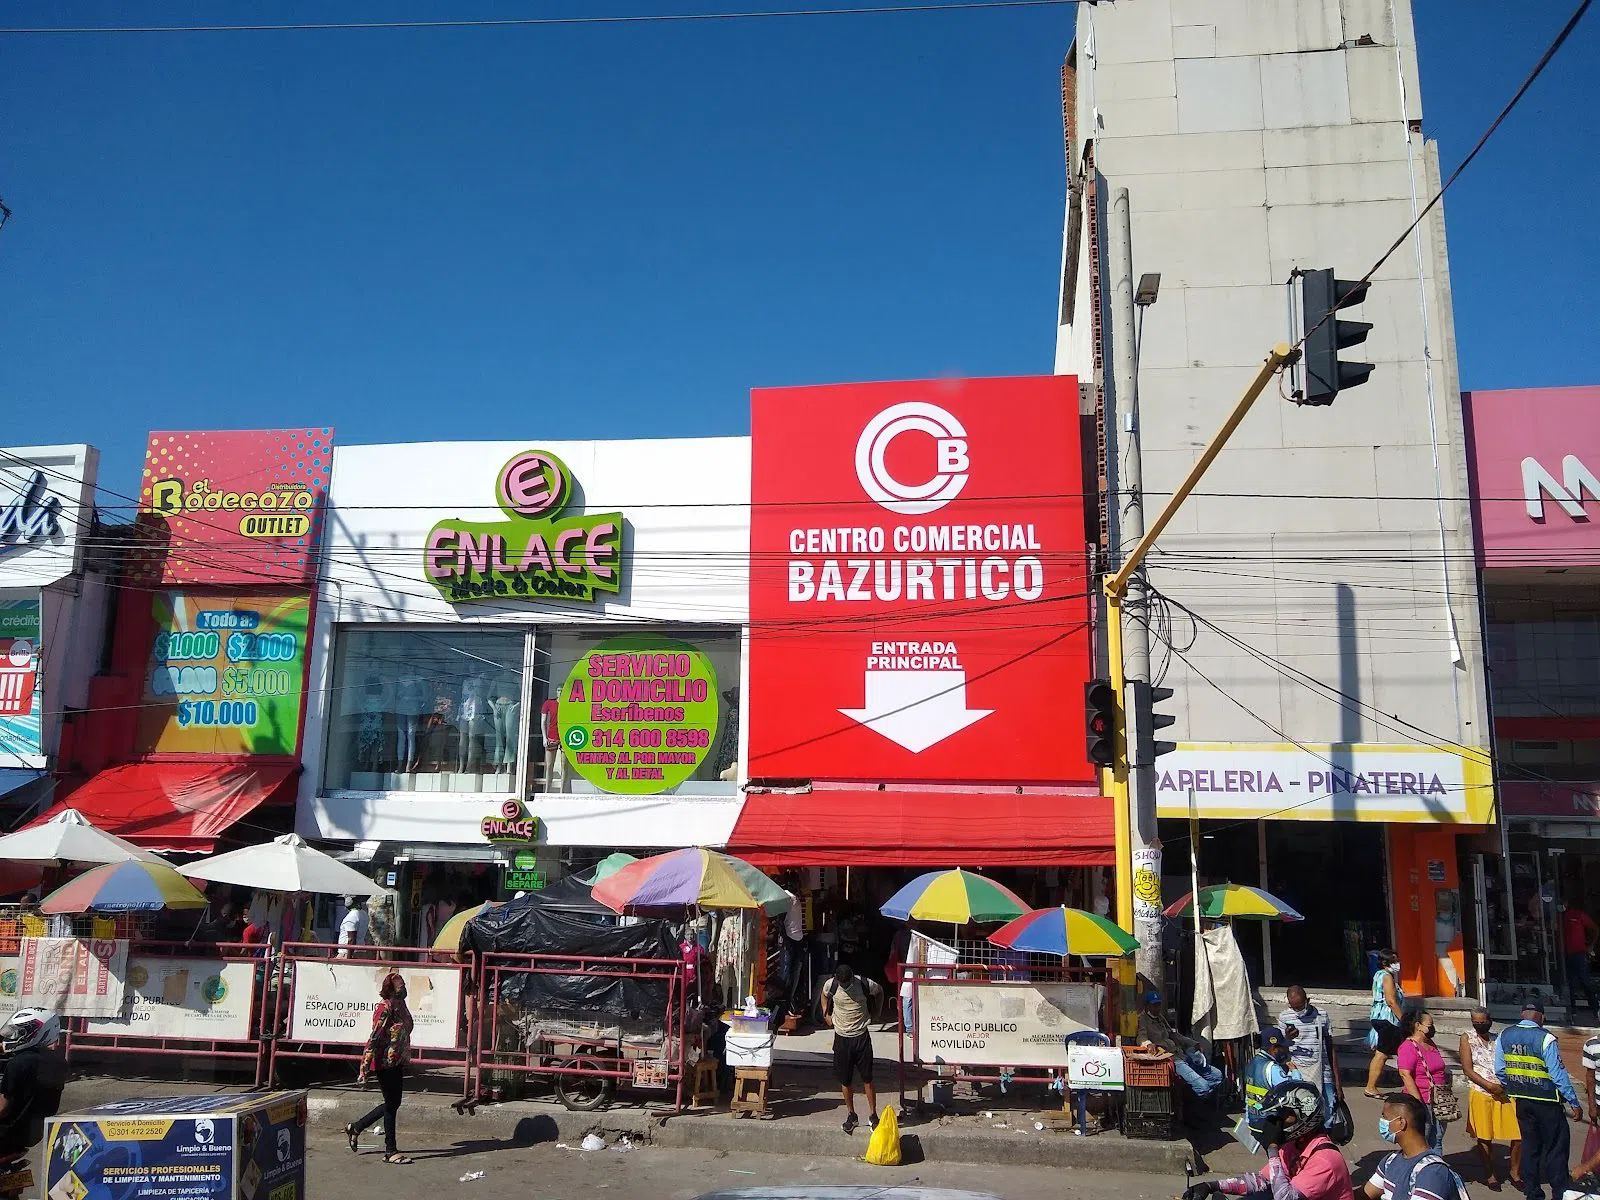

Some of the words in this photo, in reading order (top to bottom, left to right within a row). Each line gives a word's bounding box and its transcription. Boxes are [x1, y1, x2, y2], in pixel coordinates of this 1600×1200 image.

[193, 479, 211, 494] el
[246, 517, 303, 533] OUTLET
[788, 526, 885, 554] CENTRO
[893, 523, 1042, 552] COMERCIAL
[426, 522, 614, 579] ENLACE
[787, 555, 1044, 602] BAZURTICO
[203, 612, 235, 627] Todo
[239, 615, 254, 626] a:
[155, 632, 220, 660] $1.000
[228, 632, 297, 661] $2.000
[871, 641, 958, 655] ENTRADA
[587, 653, 690, 678] SERVICIO
[867, 656, 963, 669] PRINCIPAL
[222, 666, 291, 696] $5.000
[568, 679, 586, 702] A
[591, 679, 708, 703] DOMICILIO
[178, 699, 257, 726] $10.000
[591, 703, 685, 722] Escríbenos
[591, 729, 624, 748] 314
[628, 729, 661, 748] 600
[665, 729, 710, 748] 8598
[576, 752, 616, 764] VENTAS
[618, 752, 632, 764] AL
[633, 752, 656, 764] POR
[658, 752, 696, 764] MAYOR
[605, 768, 615, 780] Y
[615, 768, 630, 780] AL
[631, 768, 664, 780] DETAL
[482, 819, 534, 837] ENLACE
[513, 873, 538, 881] PLAN
[507, 880, 543, 889] SEPARE
[27, 956, 35, 965] DE
[26, 966, 34, 974] 27
[24, 976, 34, 991] ESTE
[77, 971, 86, 985] EL
[305, 1001, 344, 1011] ESPACIO
[346, 1002, 379, 1012] PUBLI
[304, 1018, 356, 1028] MOVILIDAD
[930, 1022, 971, 1032] ESPACIO
[974, 1023, 1018, 1032] PUBLICO
[930, 1040, 986, 1049] MOVILIDAD
[145, 1127, 163, 1135] 2520
[176, 1145, 201, 1153] Limpio
[208, 1144, 232, 1152] Bueno
[103, 1166, 149, 1176] SERVICIOS
[151, 1164, 221, 1174] PROFESIONALES
[114, 1175, 149, 1183] LIMPIEZA
[151, 1174, 158, 1182] Y
[158, 1174, 221, 1182] MANTENIMIENTO
[138, 1188, 167, 1196] LIMPIEZA
